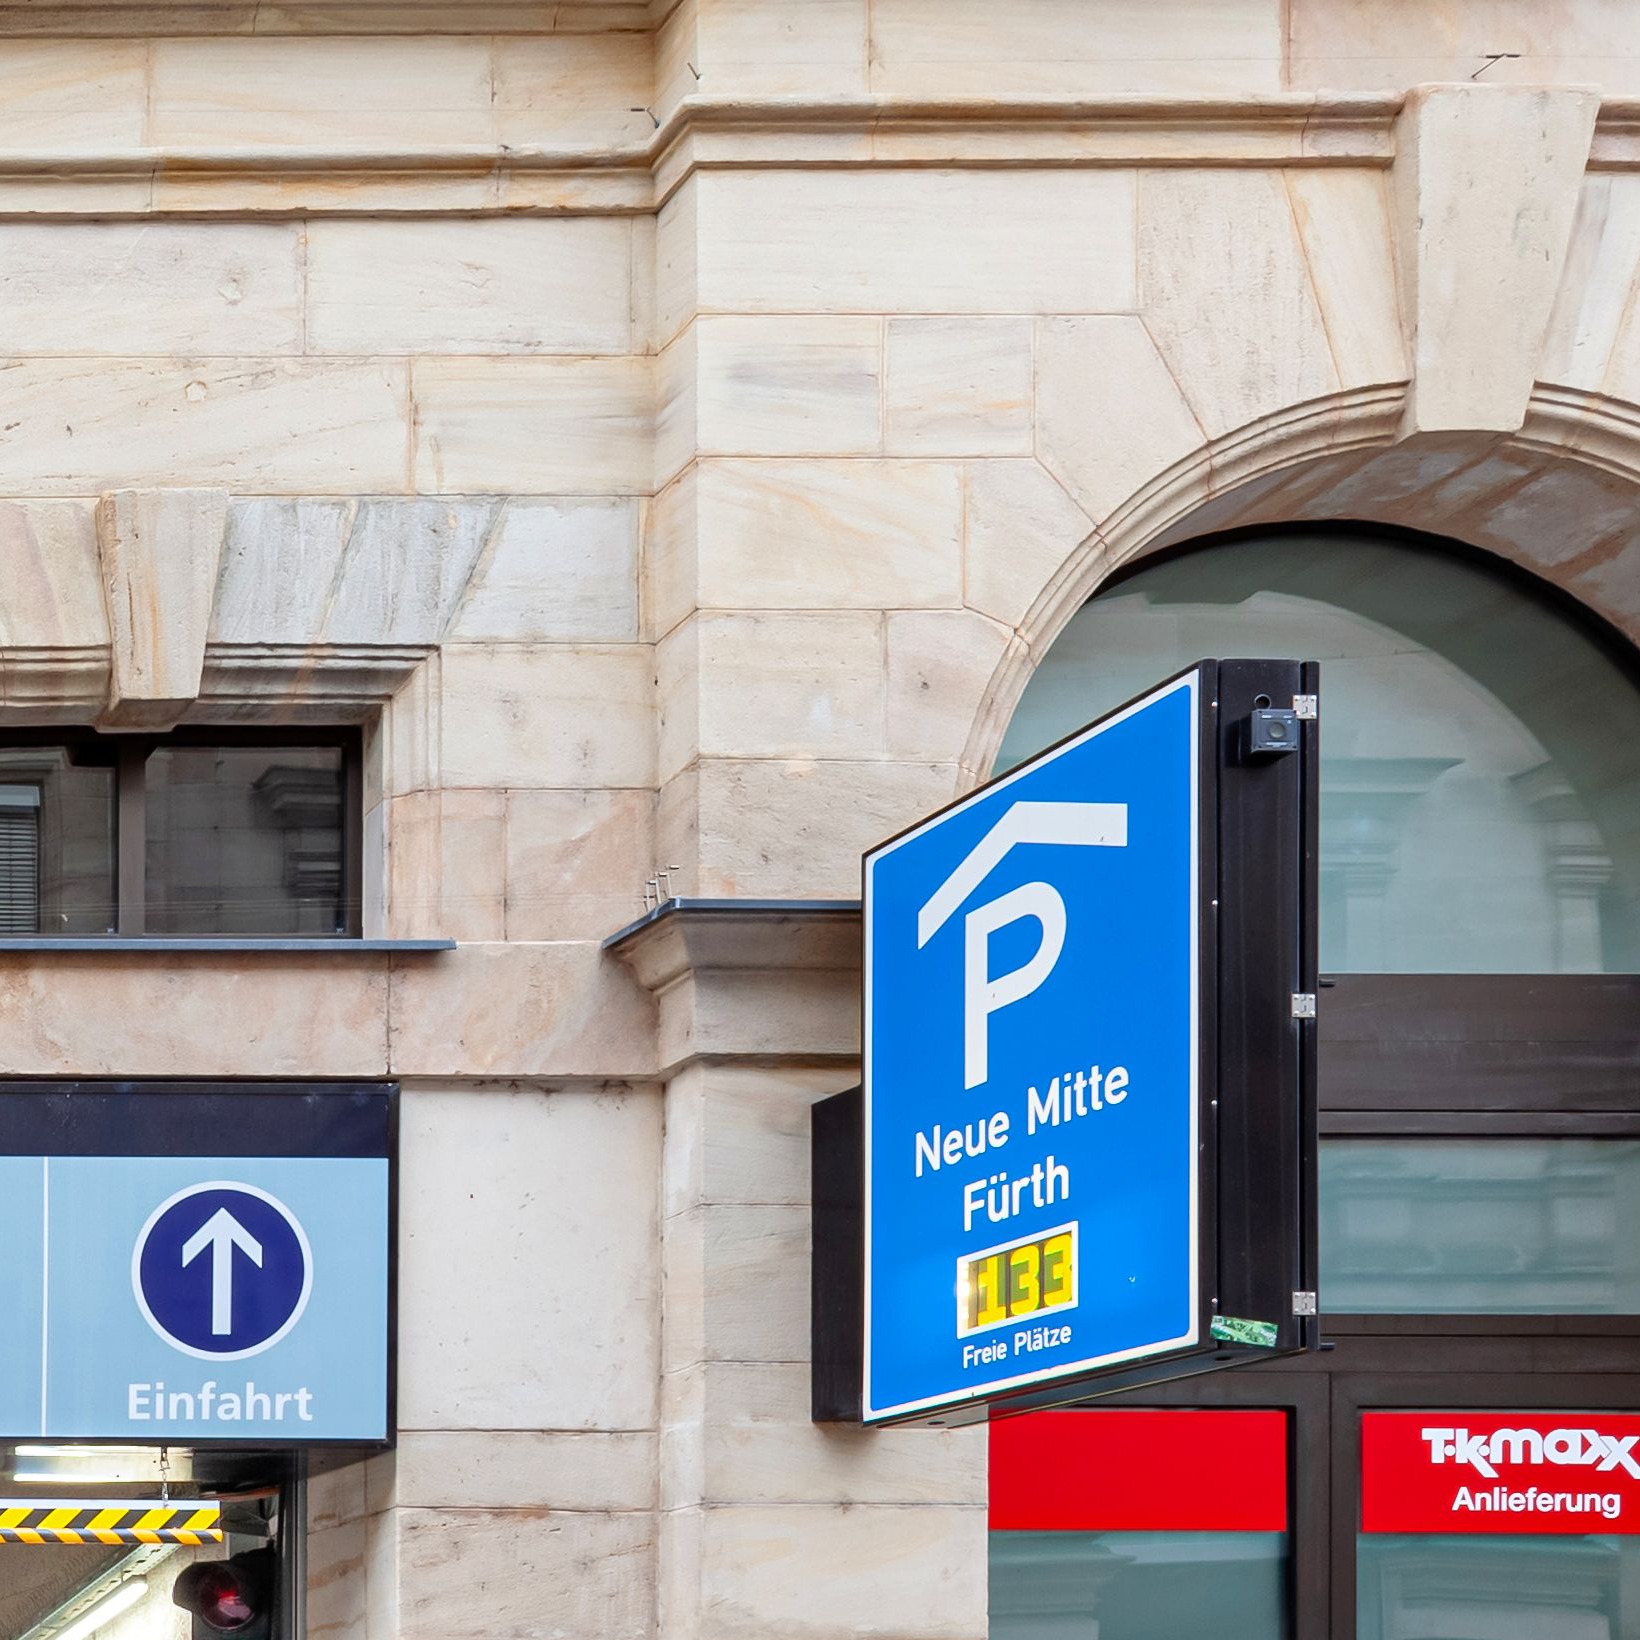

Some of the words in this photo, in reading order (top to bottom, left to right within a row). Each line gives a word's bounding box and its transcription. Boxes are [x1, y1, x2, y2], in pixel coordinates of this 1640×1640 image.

[915, 1111, 1010, 1178] Neue
[1027, 1065, 1129, 1136] Mitte
[963, 1155, 1069, 1232] Fürth
[978, 1234, 1072, 1326] 133
[963, 1340, 1007, 1369] Freie
[1014, 1325, 1072, 1356] Plätze
[127, 1381, 314, 1422] Einfahrt
[1452, 1486, 1621, 1519] Anlieferung
